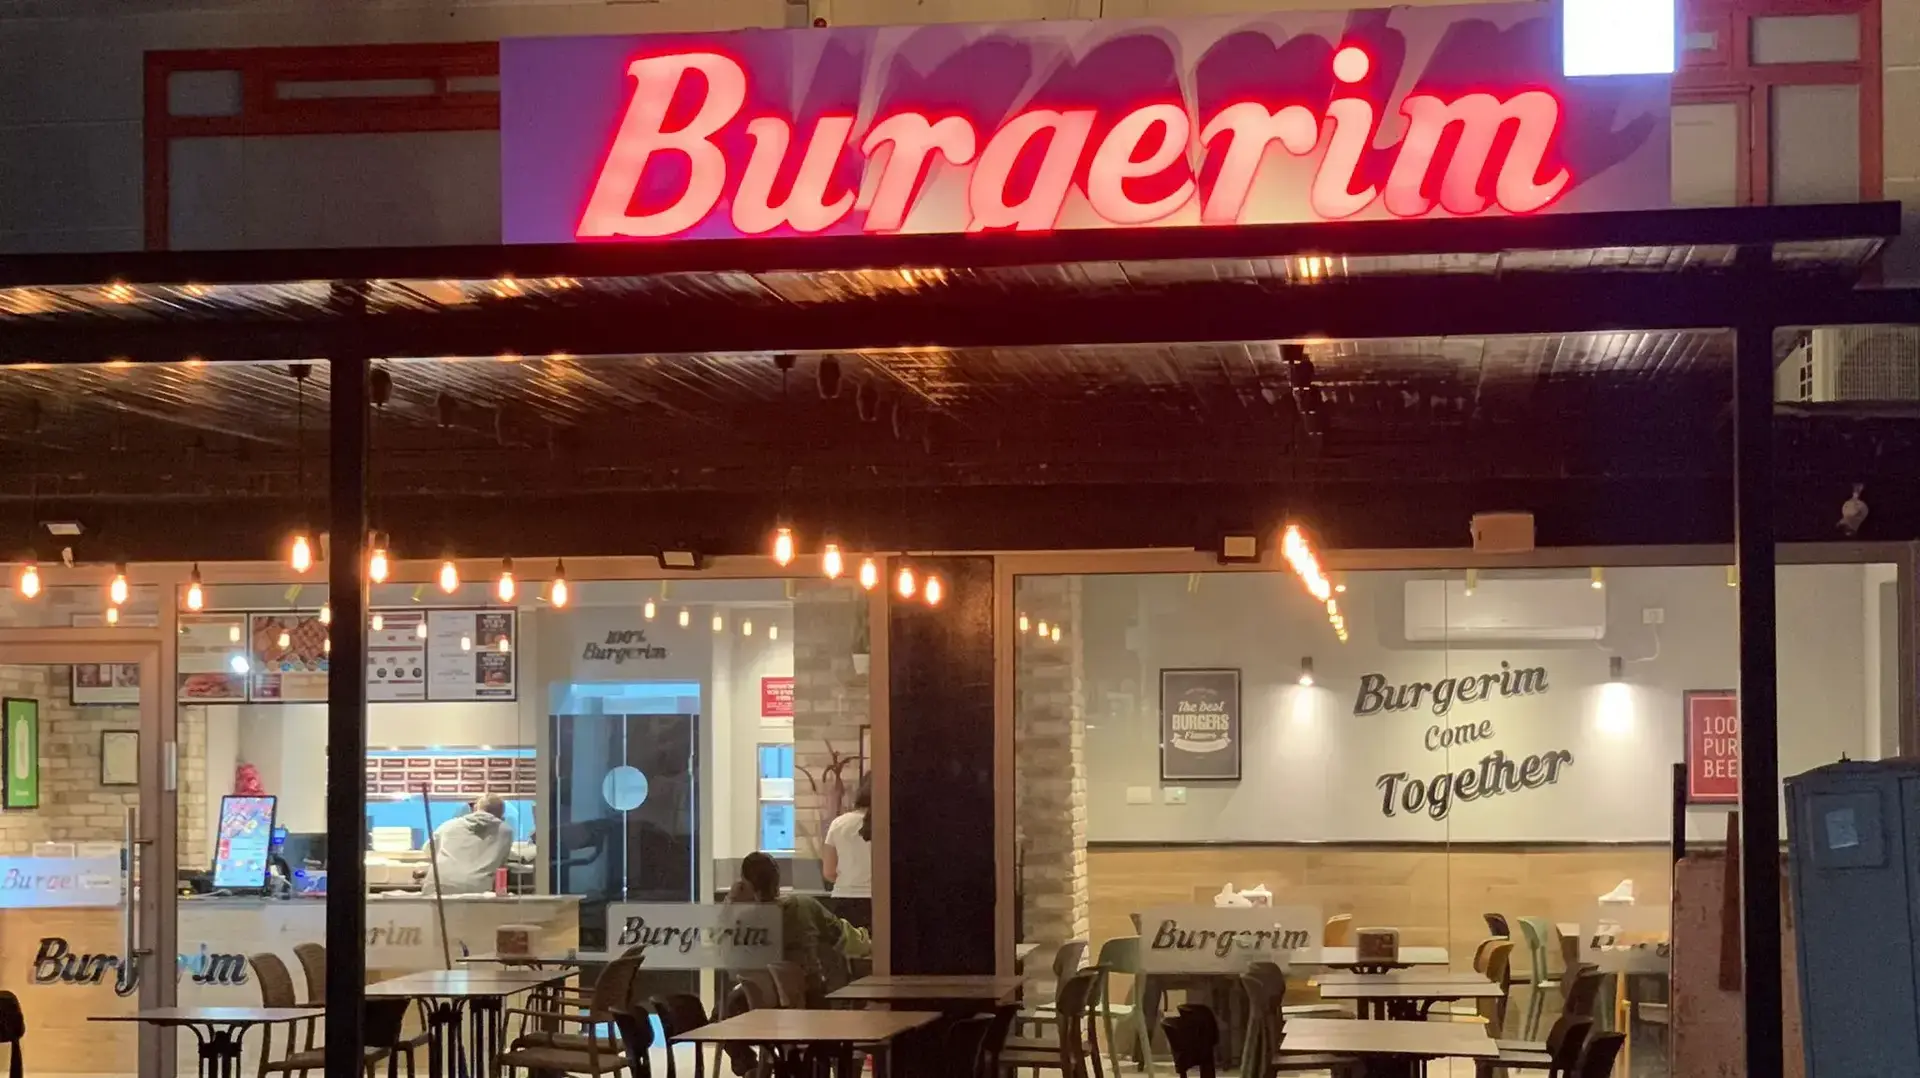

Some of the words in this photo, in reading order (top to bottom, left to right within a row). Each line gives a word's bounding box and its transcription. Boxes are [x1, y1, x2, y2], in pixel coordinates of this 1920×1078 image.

[1353, 660, 1549, 716] Burgerim
[1171, 713, 1230, 731] BURGERS
[1424, 719, 1495, 751] Come
[1703, 716, 1738, 735] 100
[1703, 738, 1738, 757] PUR
[1703, 759, 1738, 778] BEE
[1375, 749, 1574, 821] Together
[366, 920, 423, 946] rim
[33, 937, 250, 997] Burgim
